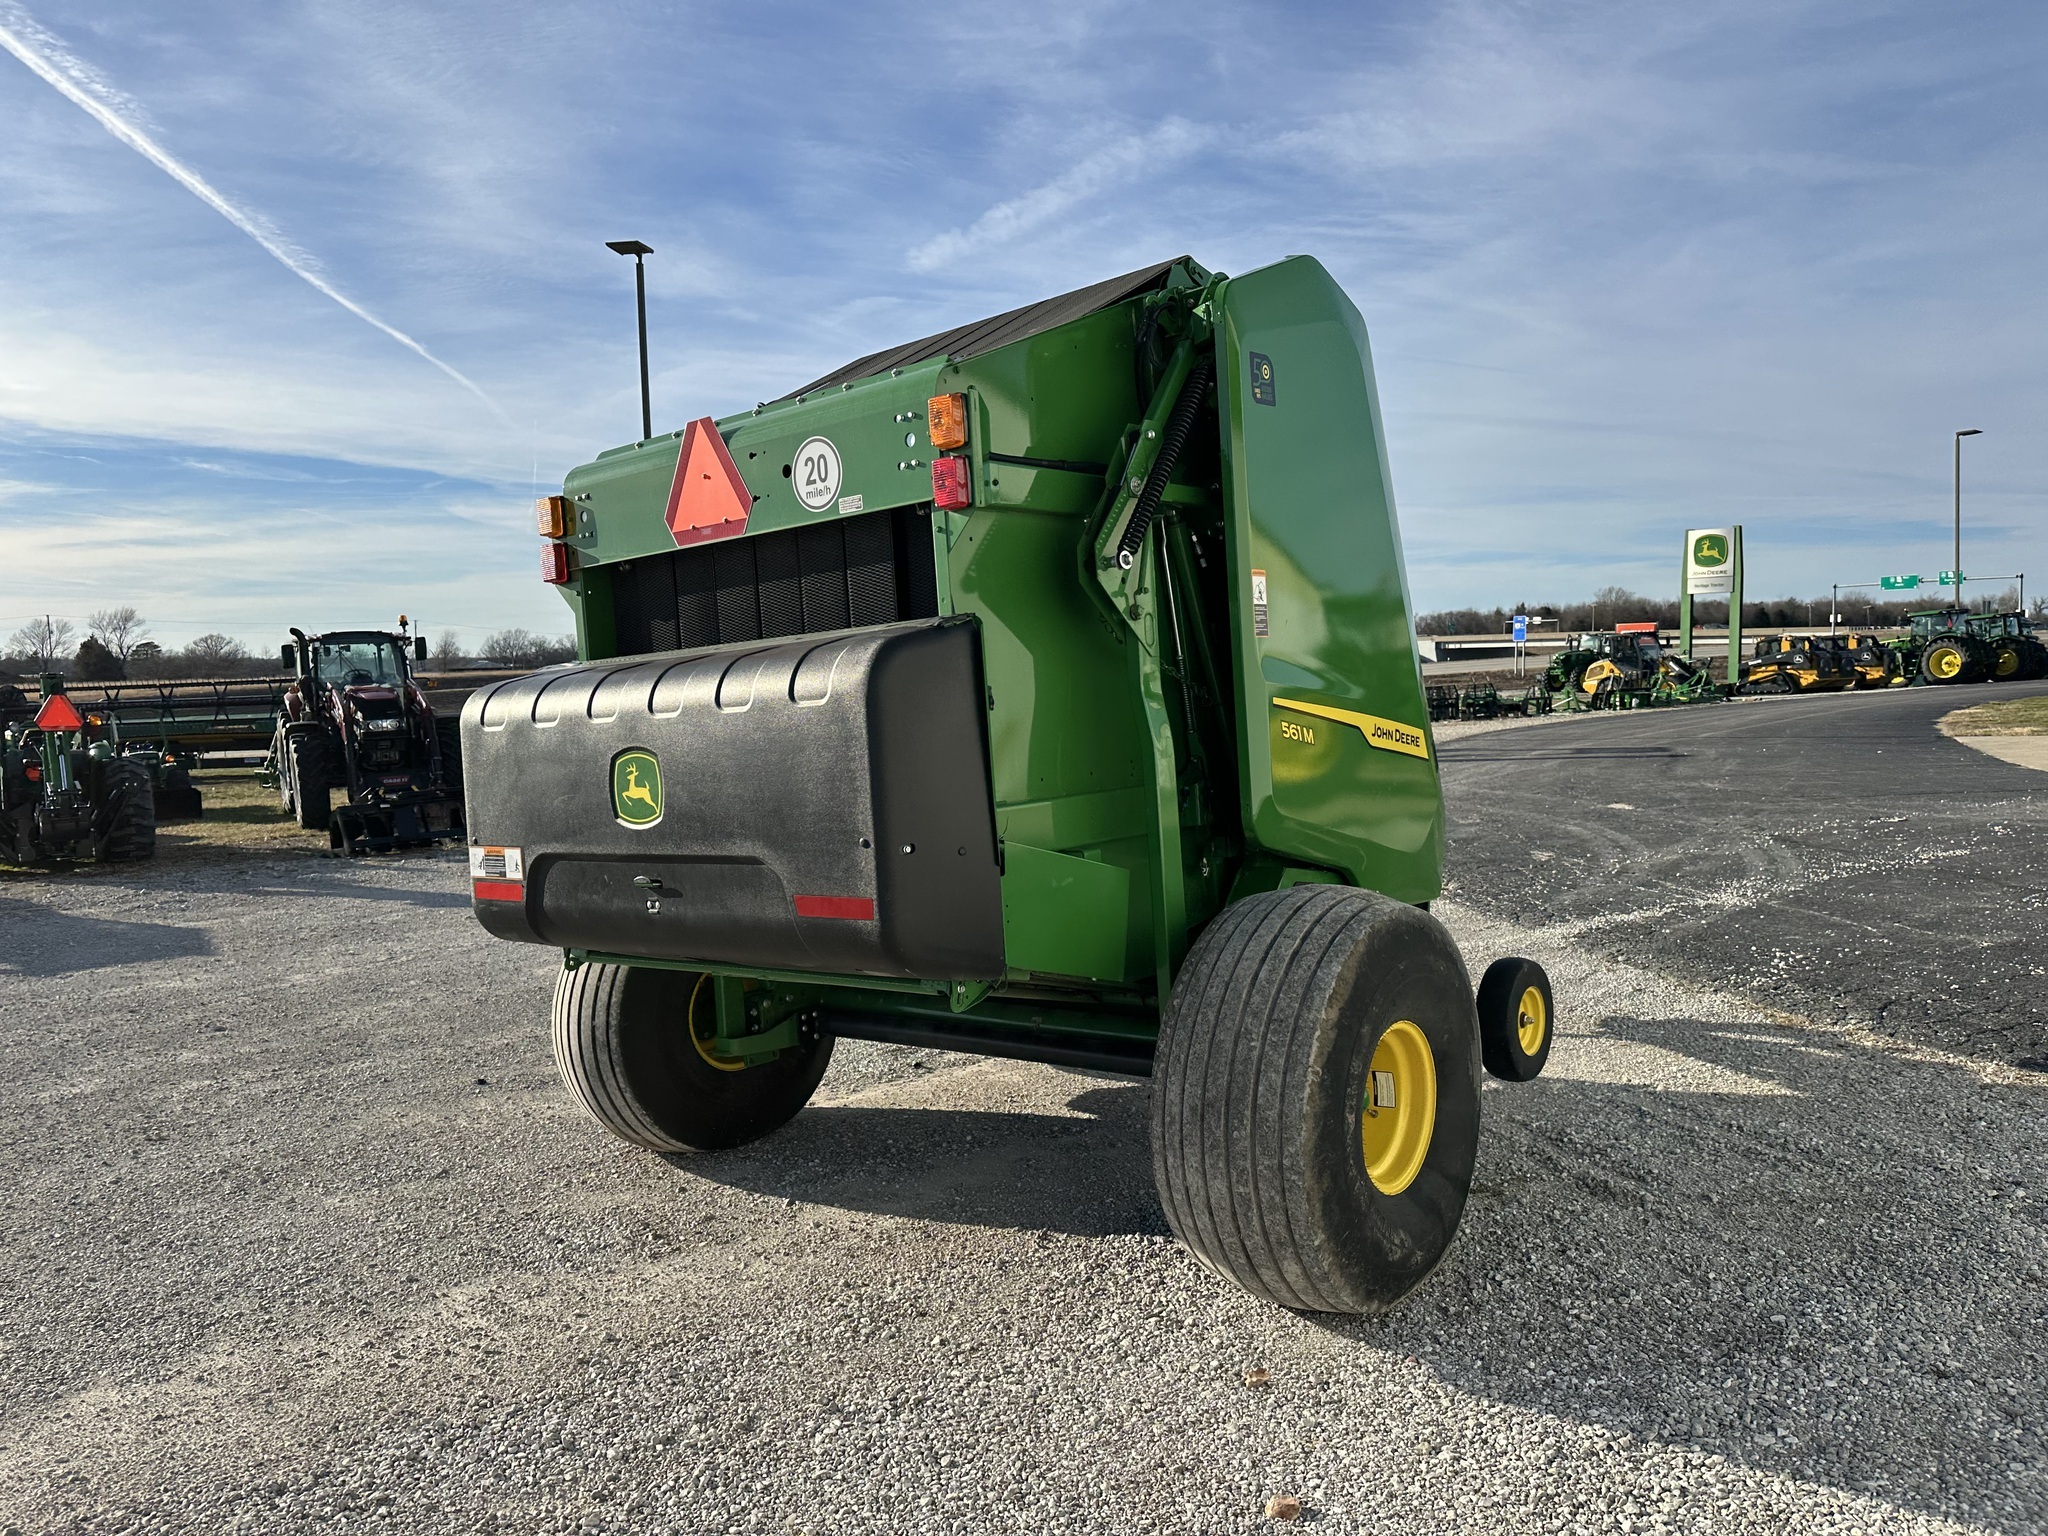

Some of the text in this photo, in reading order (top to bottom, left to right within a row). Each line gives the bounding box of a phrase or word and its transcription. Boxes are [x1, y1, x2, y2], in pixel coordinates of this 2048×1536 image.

[804, 453, 828, 486] 20
[805, 485, 831, 500] mile/h
[1371, 723, 1420, 748] JOHN DEERE
